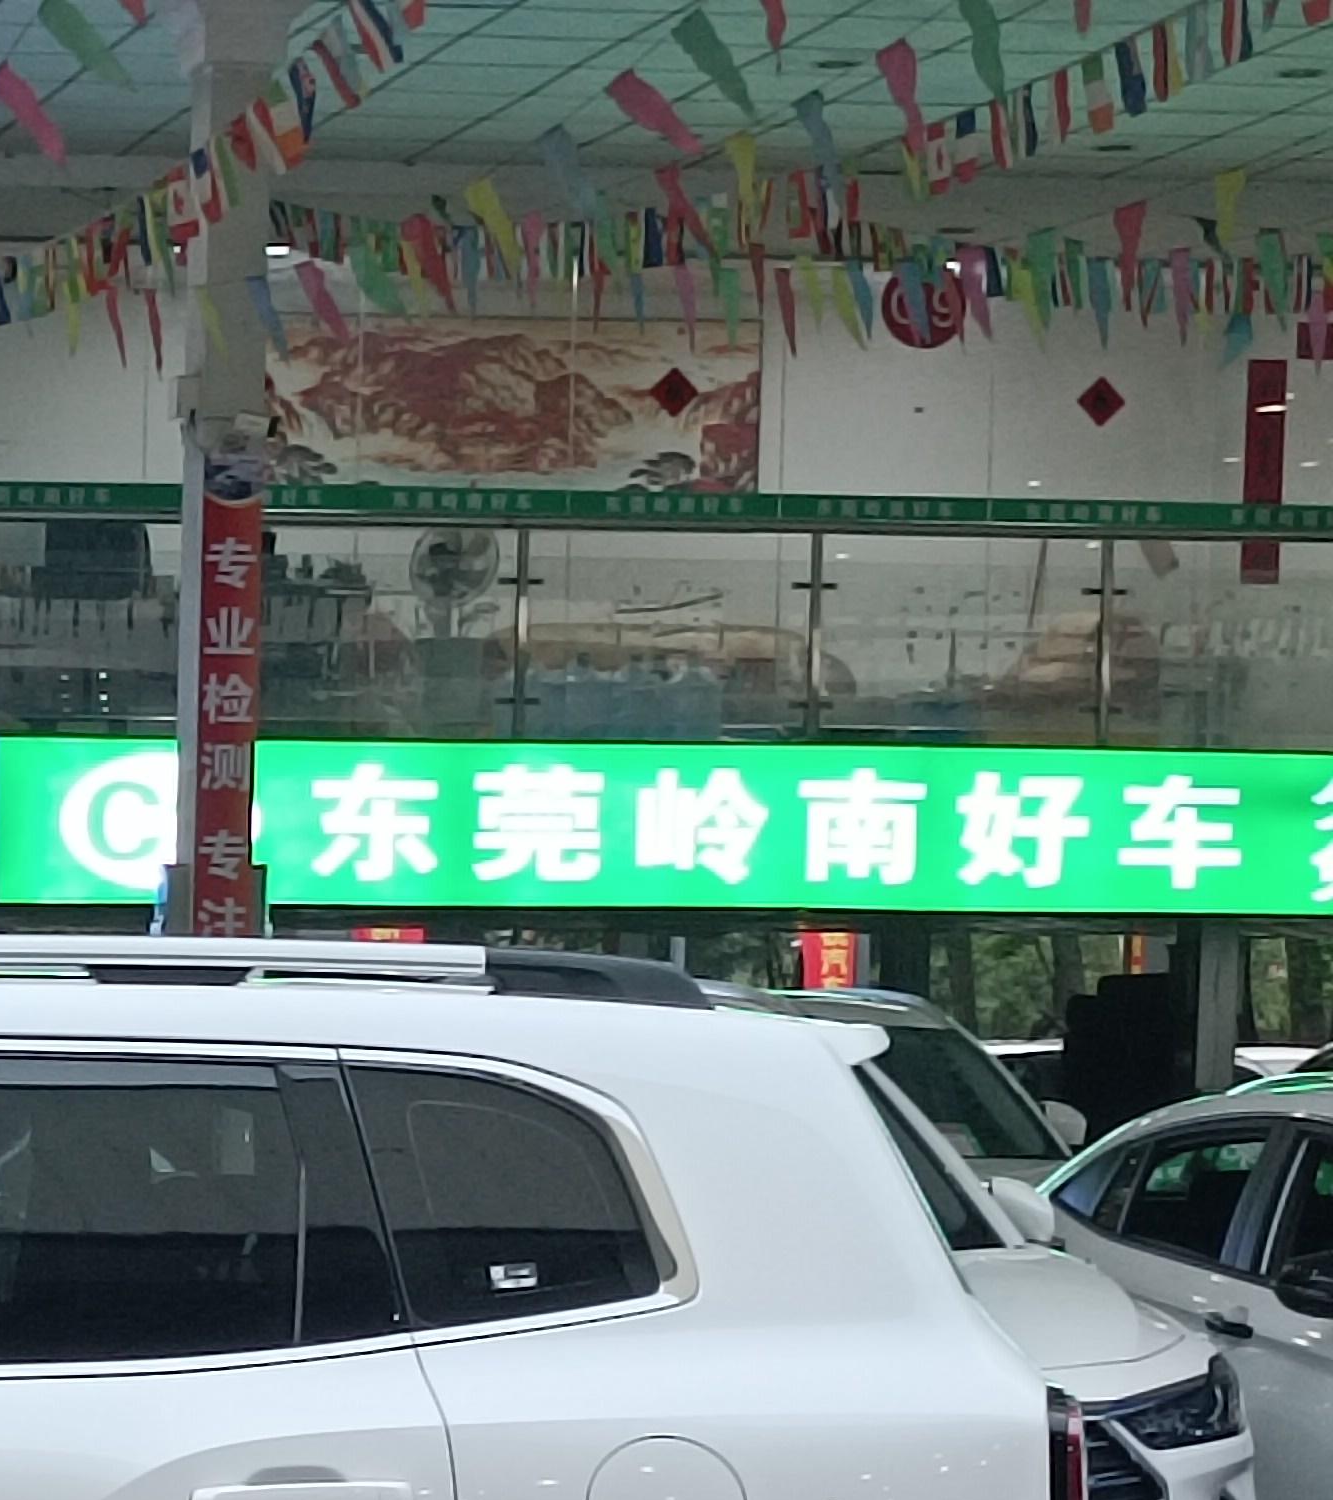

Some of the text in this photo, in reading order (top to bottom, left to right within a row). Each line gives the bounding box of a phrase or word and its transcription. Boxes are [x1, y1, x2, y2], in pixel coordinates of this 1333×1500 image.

[199, 536, 259, 791] 专业检测
[311, 761, 1333, 902] 东莞岭南好车
